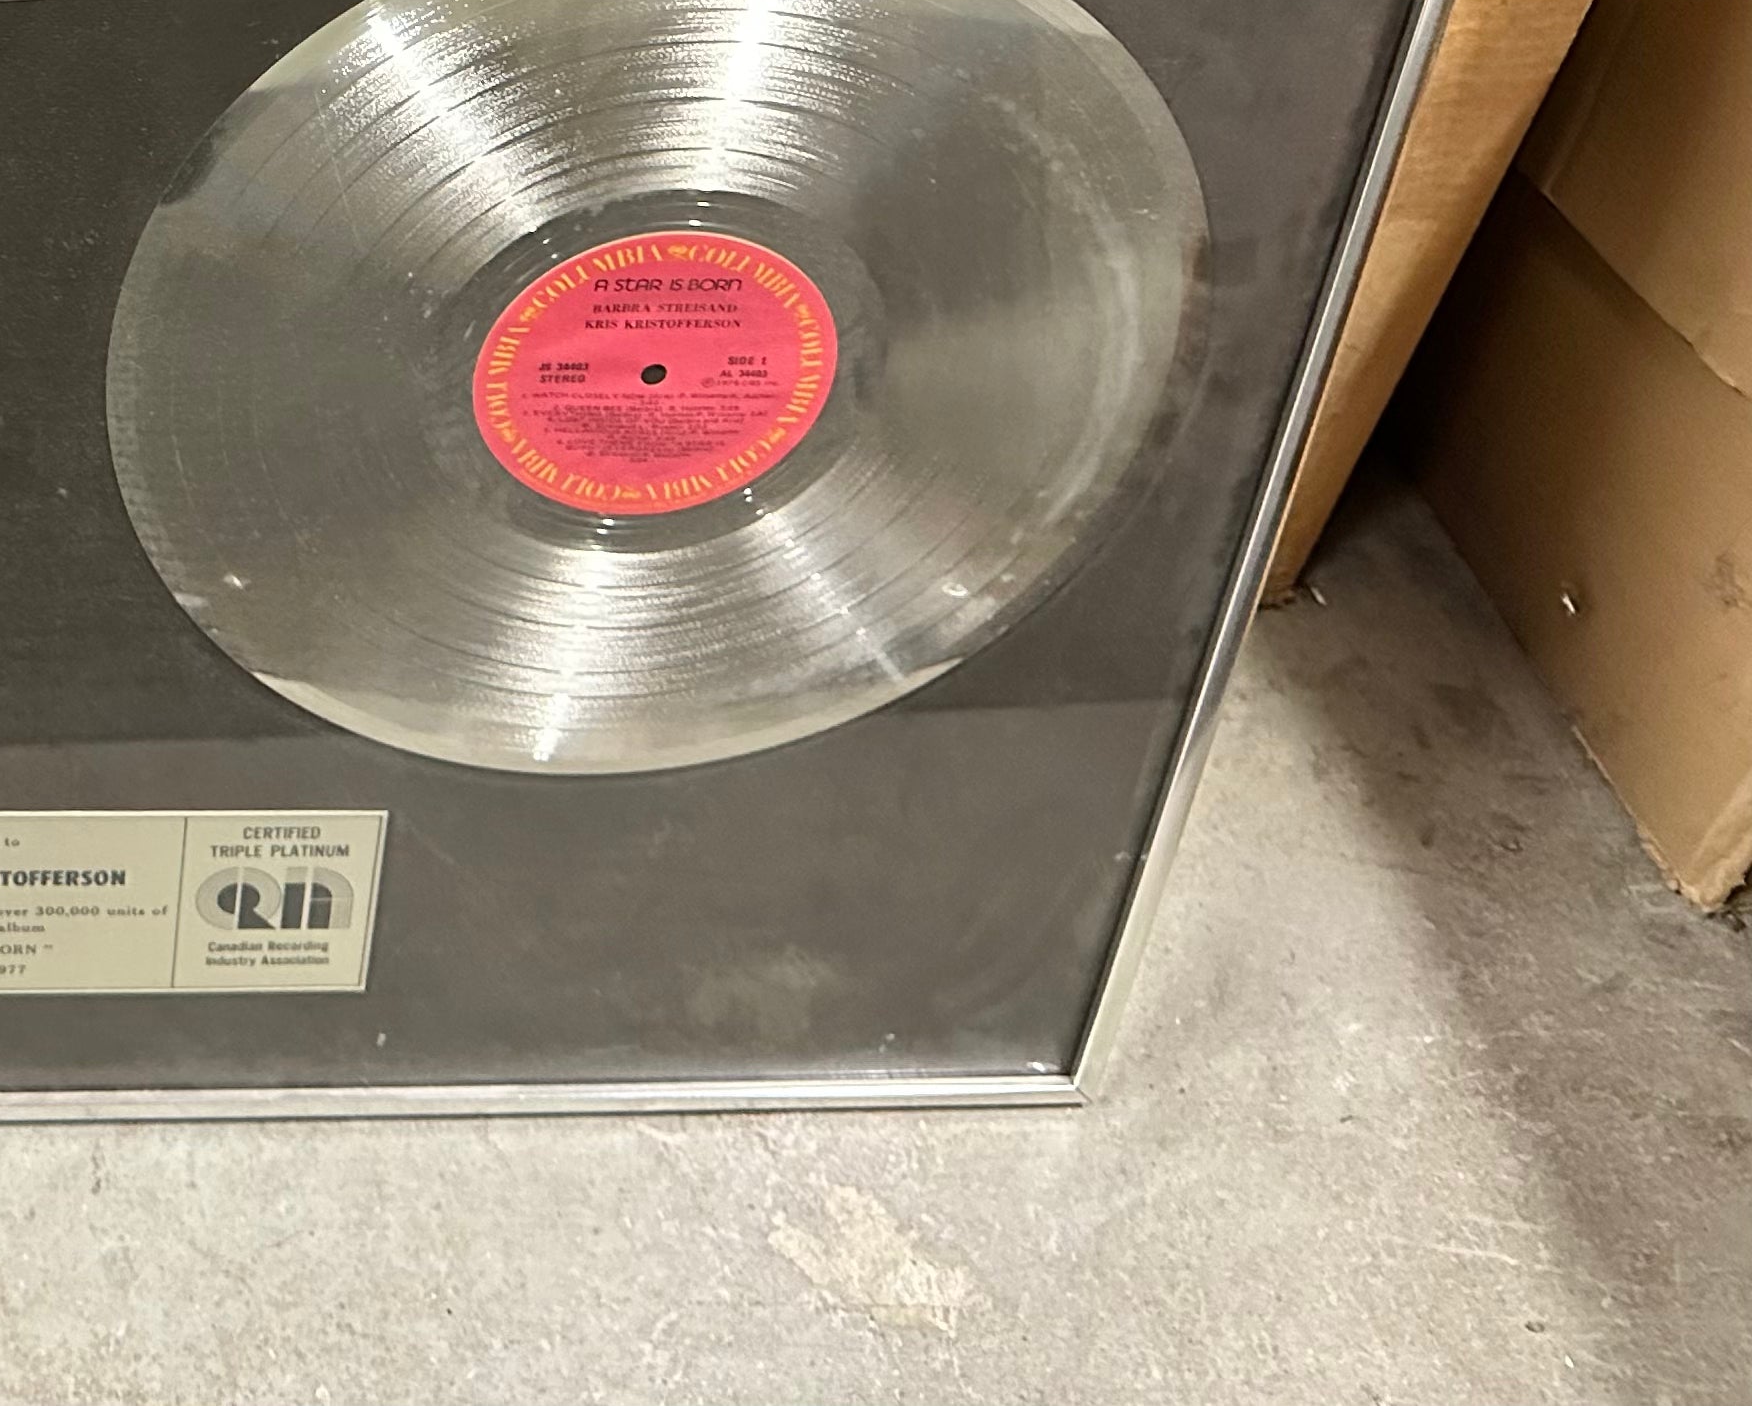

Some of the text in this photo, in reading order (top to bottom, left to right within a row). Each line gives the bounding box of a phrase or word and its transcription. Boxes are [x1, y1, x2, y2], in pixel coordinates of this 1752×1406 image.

[532, 244, 663, 310] COLUMBIA
[688, 244, 802, 309] COLUMBIA
[593, 277, 743, 292] A STAR IS BORN
[592, 302, 738, 314] BARBRA STREISAND
[584, 318, 742, 330] KRIS KRISTOFFERSON
[727, 356, 754, 365] SIDE
[778, 317, 824, 423] COLUMBIA
[485, 326, 531, 431] COLUMBIA
[539, 374, 586, 384] STEREO
[243, 825, 322, 840] CERTIFIED
[4, 835, 21, 848] to
[210, 844, 350, 859] TRIPLE PLATINUM
[34, 905, 100, 919] 300,000
[106, 904, 146, 918] units
[151, 904, 169, 917] of
[207, 940, 329, 954] Canadian Recording
[205, 954, 329, 968] Industry Association
